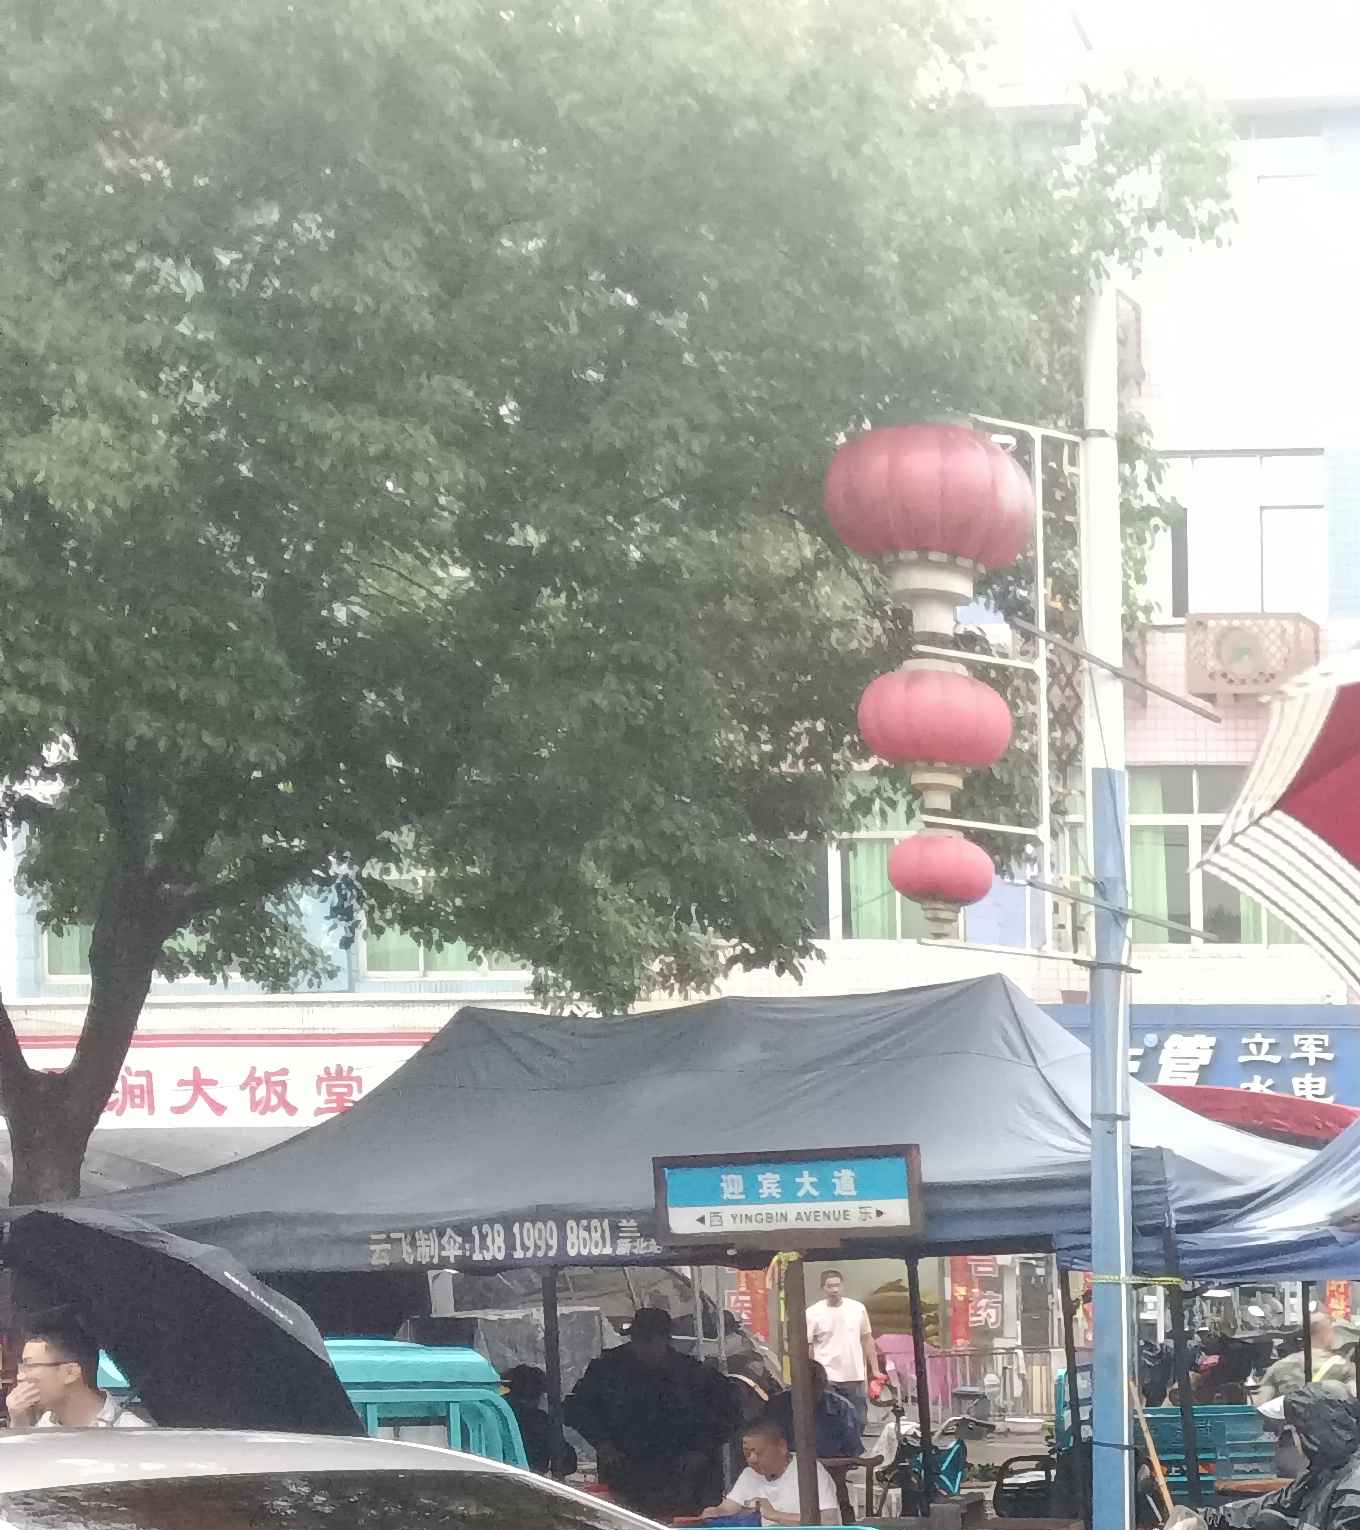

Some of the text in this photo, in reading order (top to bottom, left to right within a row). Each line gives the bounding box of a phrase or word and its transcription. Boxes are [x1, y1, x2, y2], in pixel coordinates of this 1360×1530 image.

[1127, 1033, 1217, 1086] 管
[1238, 1032, 1335, 1066] 立军
[42, 1064, 363, 1117] 涧大饭堂
[720, 1168, 857, 1201] 迎宾大道
[730, 1212, 789, 1225] YINGBIN
[795, 1208, 851, 1222] AVENUE
[512, 1220, 558, 1259] 1999
[565, 1218, 613, 1257] 8681
